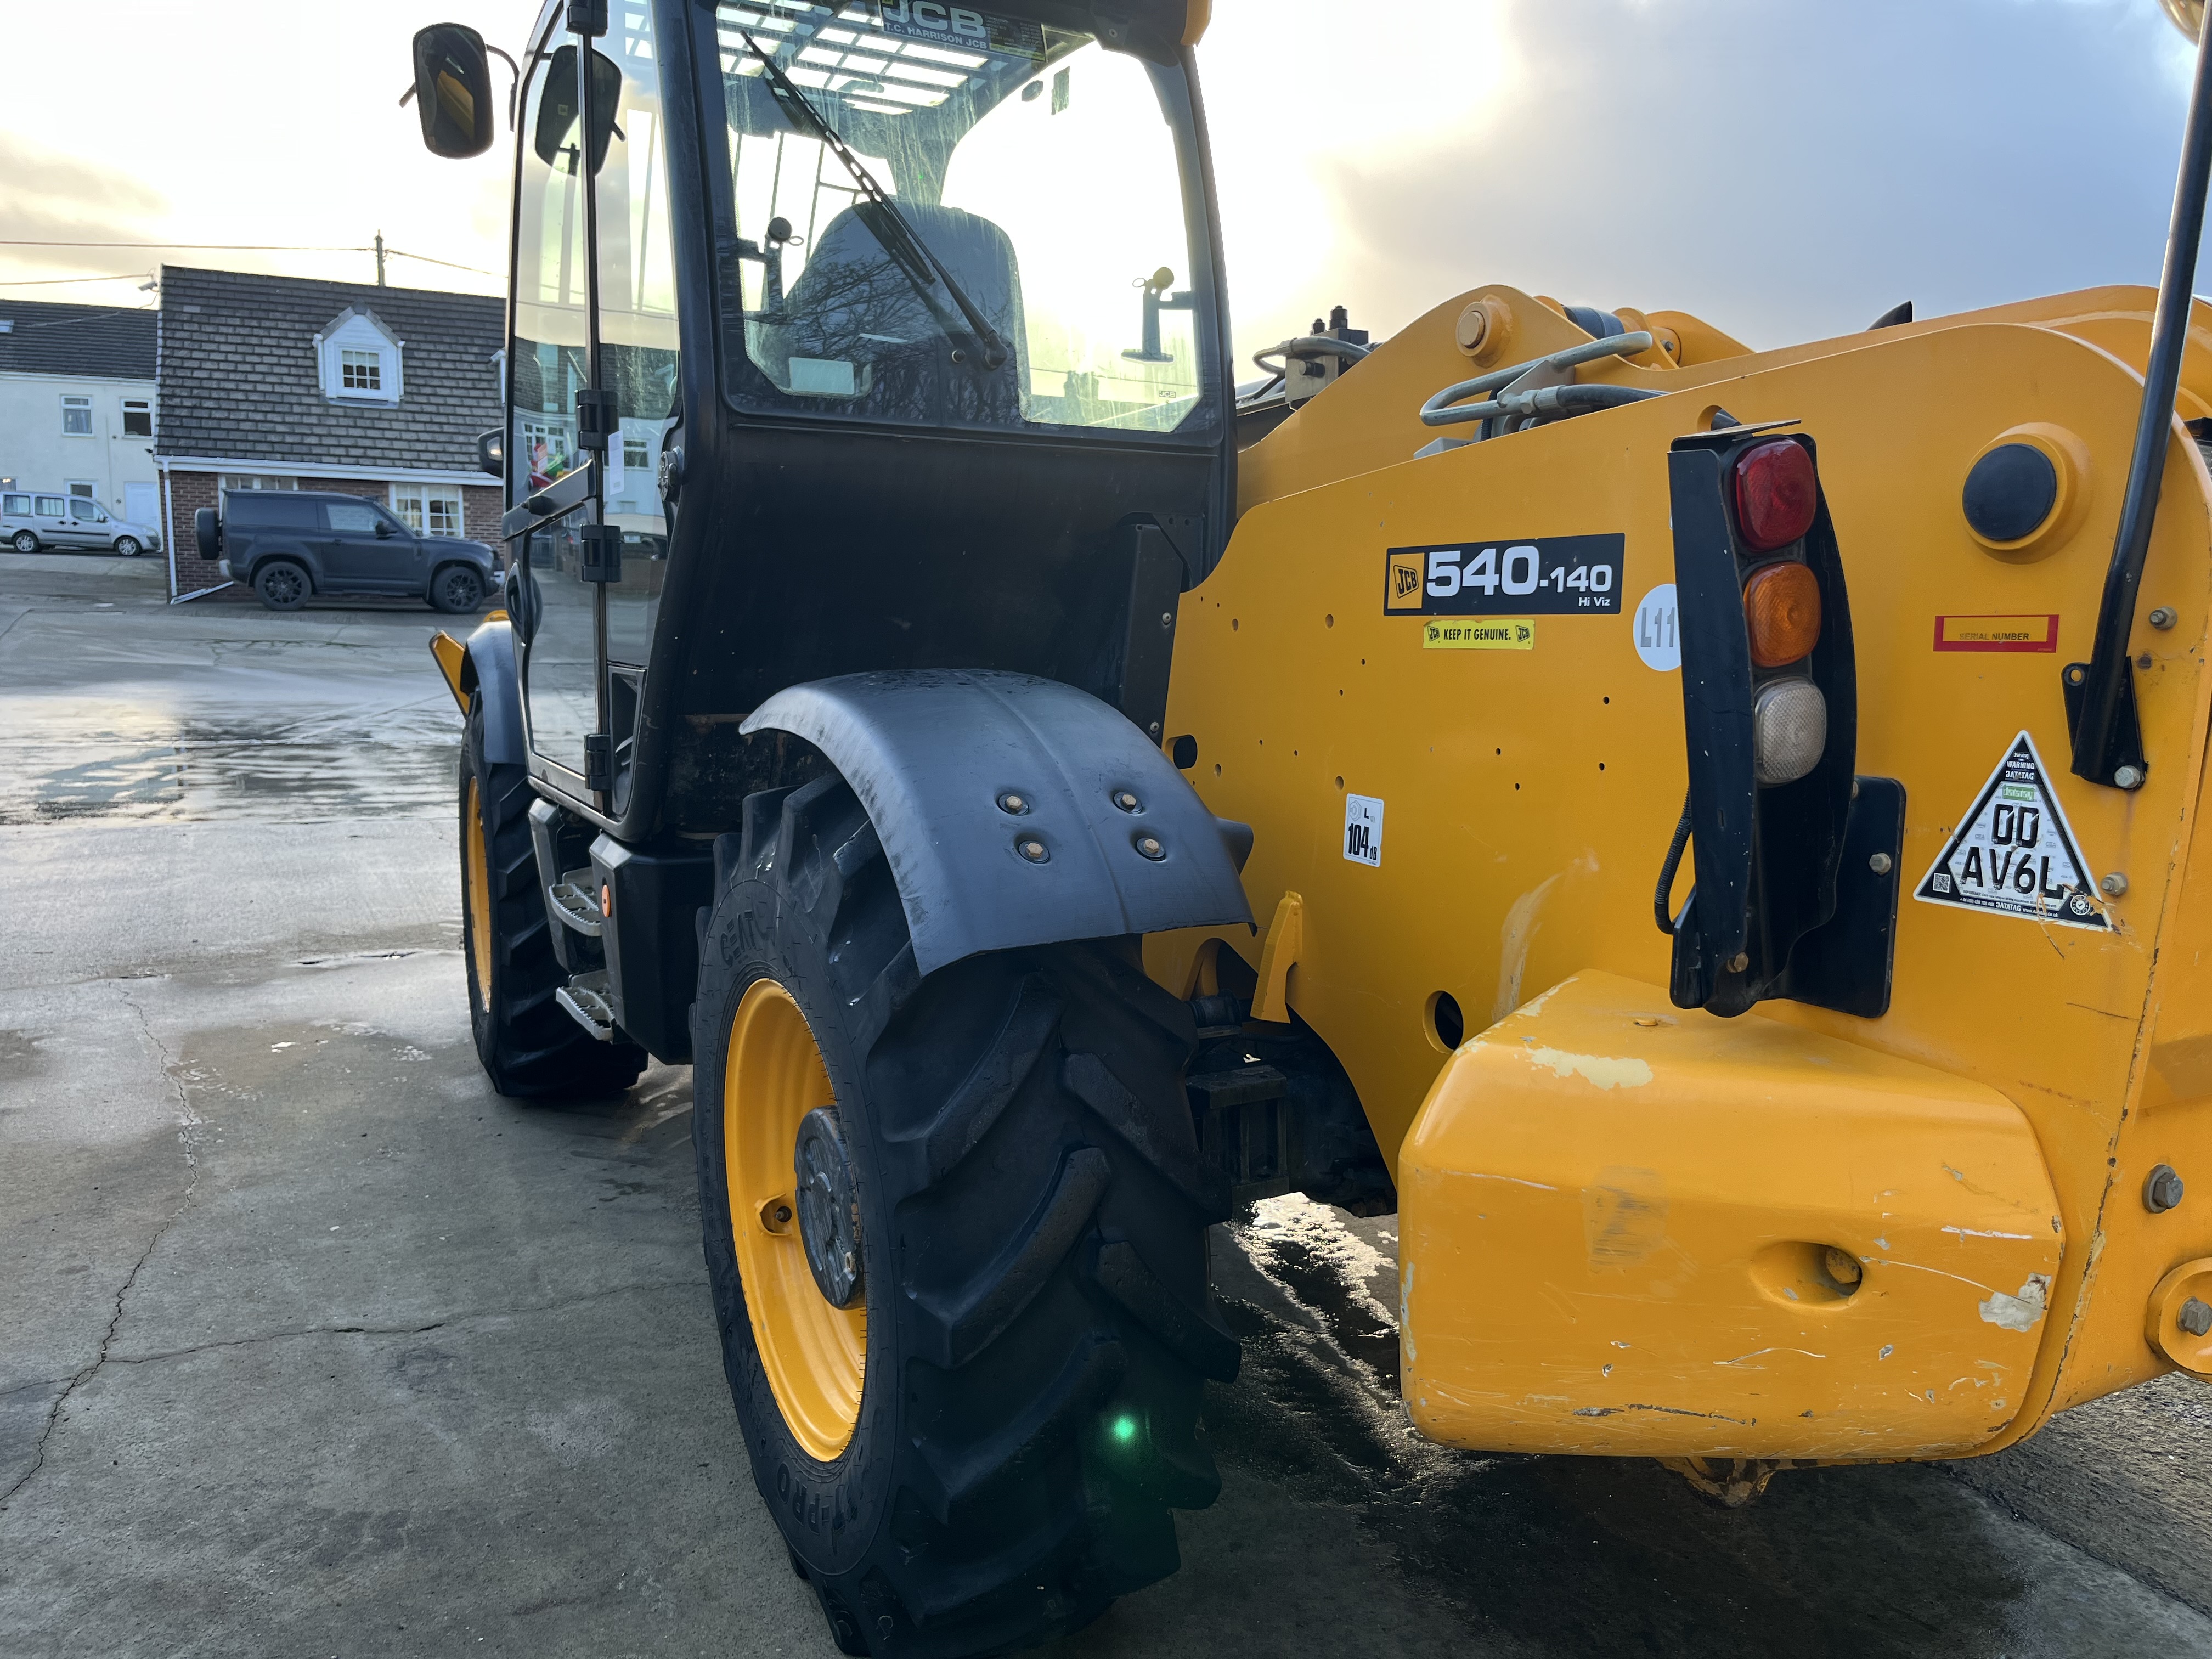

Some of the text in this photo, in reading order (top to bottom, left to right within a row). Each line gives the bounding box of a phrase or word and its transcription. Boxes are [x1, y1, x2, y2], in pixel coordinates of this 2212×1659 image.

[883, 0, 986, 38] JCB
[885, 22, 987, 49] T.C. HARRISON JCB
[1426, 545, 1612, 597] 540-140
[1397, 569, 1418, 595] JCB
[1578, 596, 1610, 607] Hi Viz
[1429, 627, 1530, 641] JCB KEEP IT GENUINE. JCB
[1991, 633, 2029, 641] NUMBER
[2007, 761, 2035, 770] WARNING
[1364, 808, 1369, 819] L
[1348, 823, 1378, 860] 104 dB
[1960, 846, 2064, 899] AV6L
[1996, 901, 2022, 912] DATATAG
